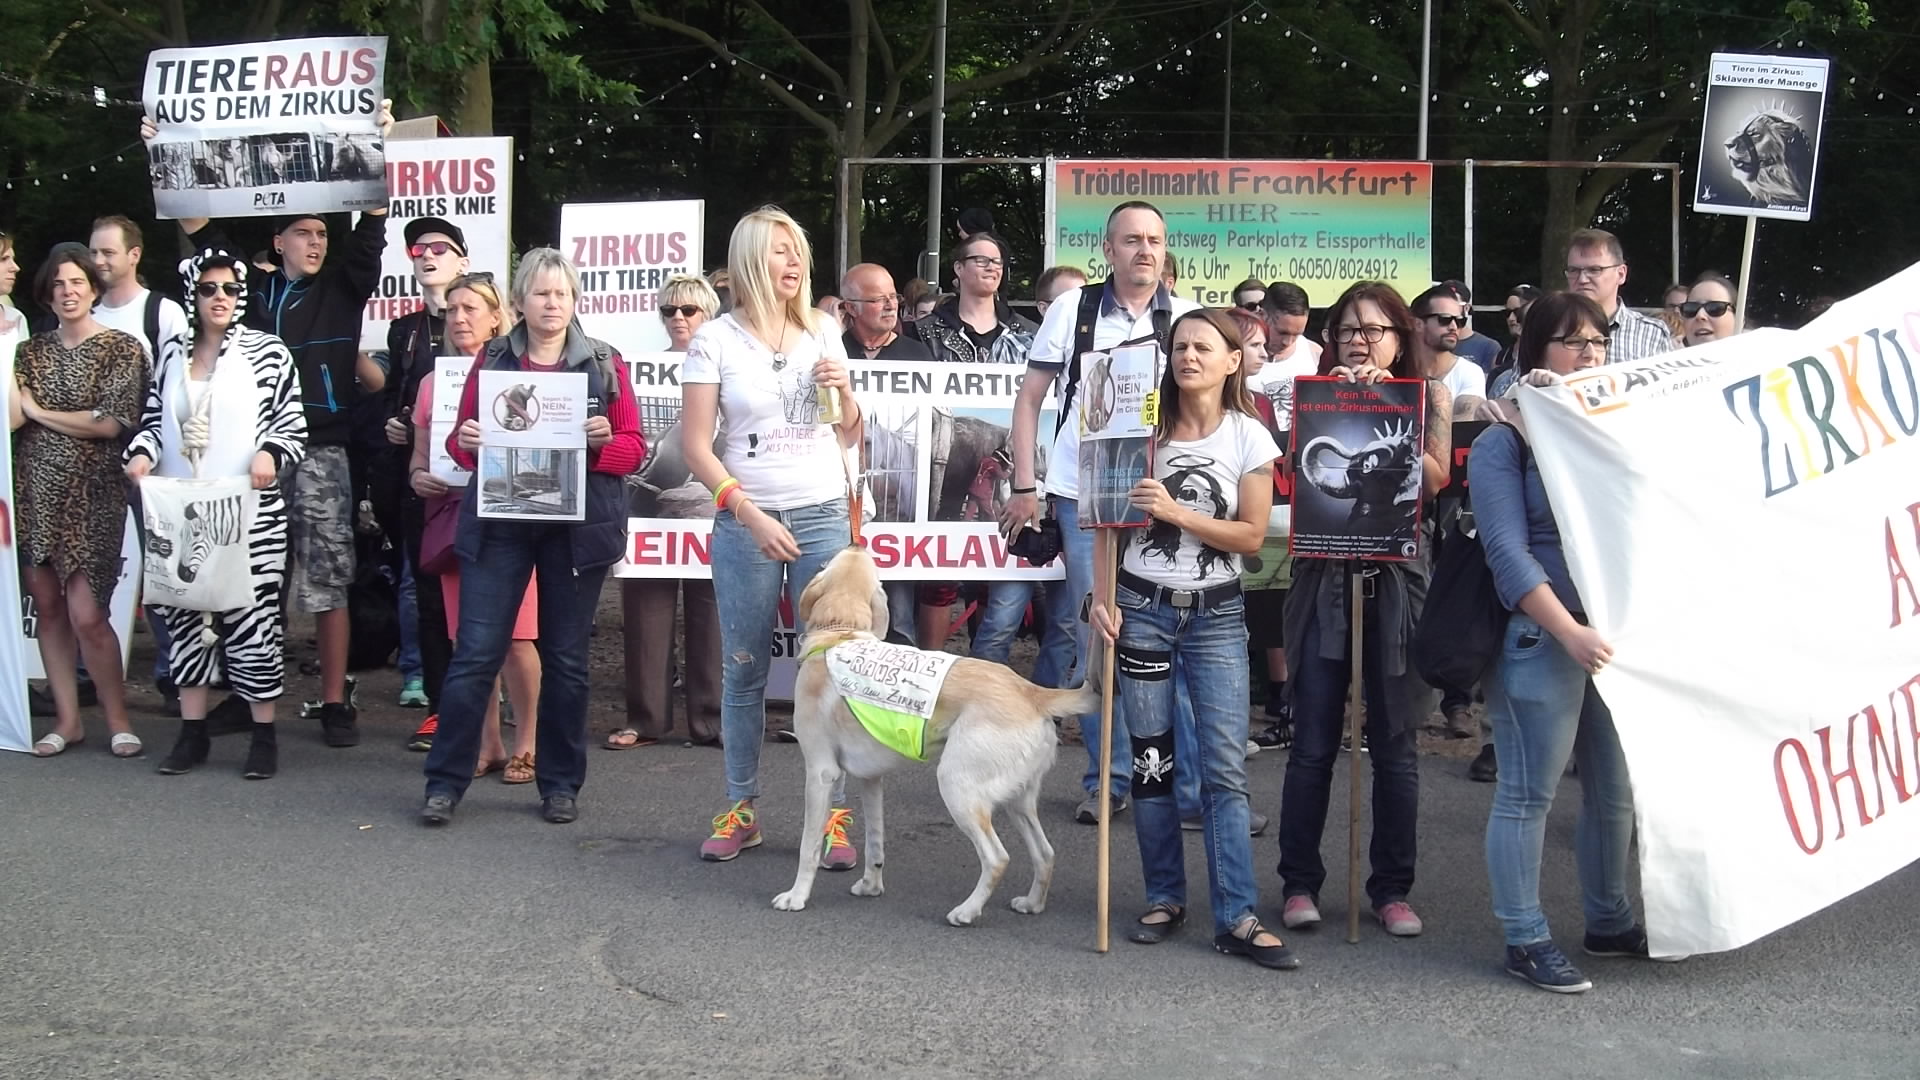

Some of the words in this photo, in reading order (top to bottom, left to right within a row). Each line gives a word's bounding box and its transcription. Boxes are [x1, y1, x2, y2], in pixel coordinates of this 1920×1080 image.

[155, 56, 259, 95] TIERE
[264, 47, 378, 91] RAUS
[1732, 64, 1755, 73] Tiere
[1771, 67, 1804, 76] Zirkus:
[1714, 74, 1755, 84] Sklaven
[1757, 77, 1775, 85] der
[1777, 78, 1818, 89] Manege
[155, 98, 206, 124] AUS
[216, 94, 271, 121] DEM
[280, 87, 376, 117] ZIRKUS
[386, 157, 495, 197] IRKUS
[1072, 168, 1219, 196] Trödelmarkt
[1228, 167, 1418, 196] Frankfurt
[387, 198, 447, 219] ARLES
[455, 196, 496, 215] KNIE
[1206, 203, 1280, 223] HIER
[1767, 203, 1790, 211] Animal
[571, 231, 687, 268] ZIRKUS
[1059, 228, 1103, 252] Festpl
[1165, 229, 1217, 253] atsweg
[1227, 230, 1308, 252] Parkplatz
[1316, 231, 1427, 253] Eissporthalle
[1203, 256, 1231, 280] Uhr
[1248, 257, 1283, 280] Info:
[1289, 257, 1399, 281] 06050/8024912
[577, 293, 659, 315] GNORIER
[850, 369, 932, 394] HTEN
[1117, 383, 1141, 395] NEIN
[542, 402, 566, 410] NEIN
[1335, 391, 1358, 399] Kein
[444, 404, 458, 412] Tra
[1125, 405, 1142, 413] Circu
[1145, 392, 1155, 426] sen
[1300, 402, 1312, 411] ist
[1314, 403, 1336, 411] eine
[1339, 402, 1414, 413] Zirkusnummer
[763, 427, 816, 441] WILDTIERE
[624, 531, 713, 566] EIN
[850, 656, 901, 686] RAUS
